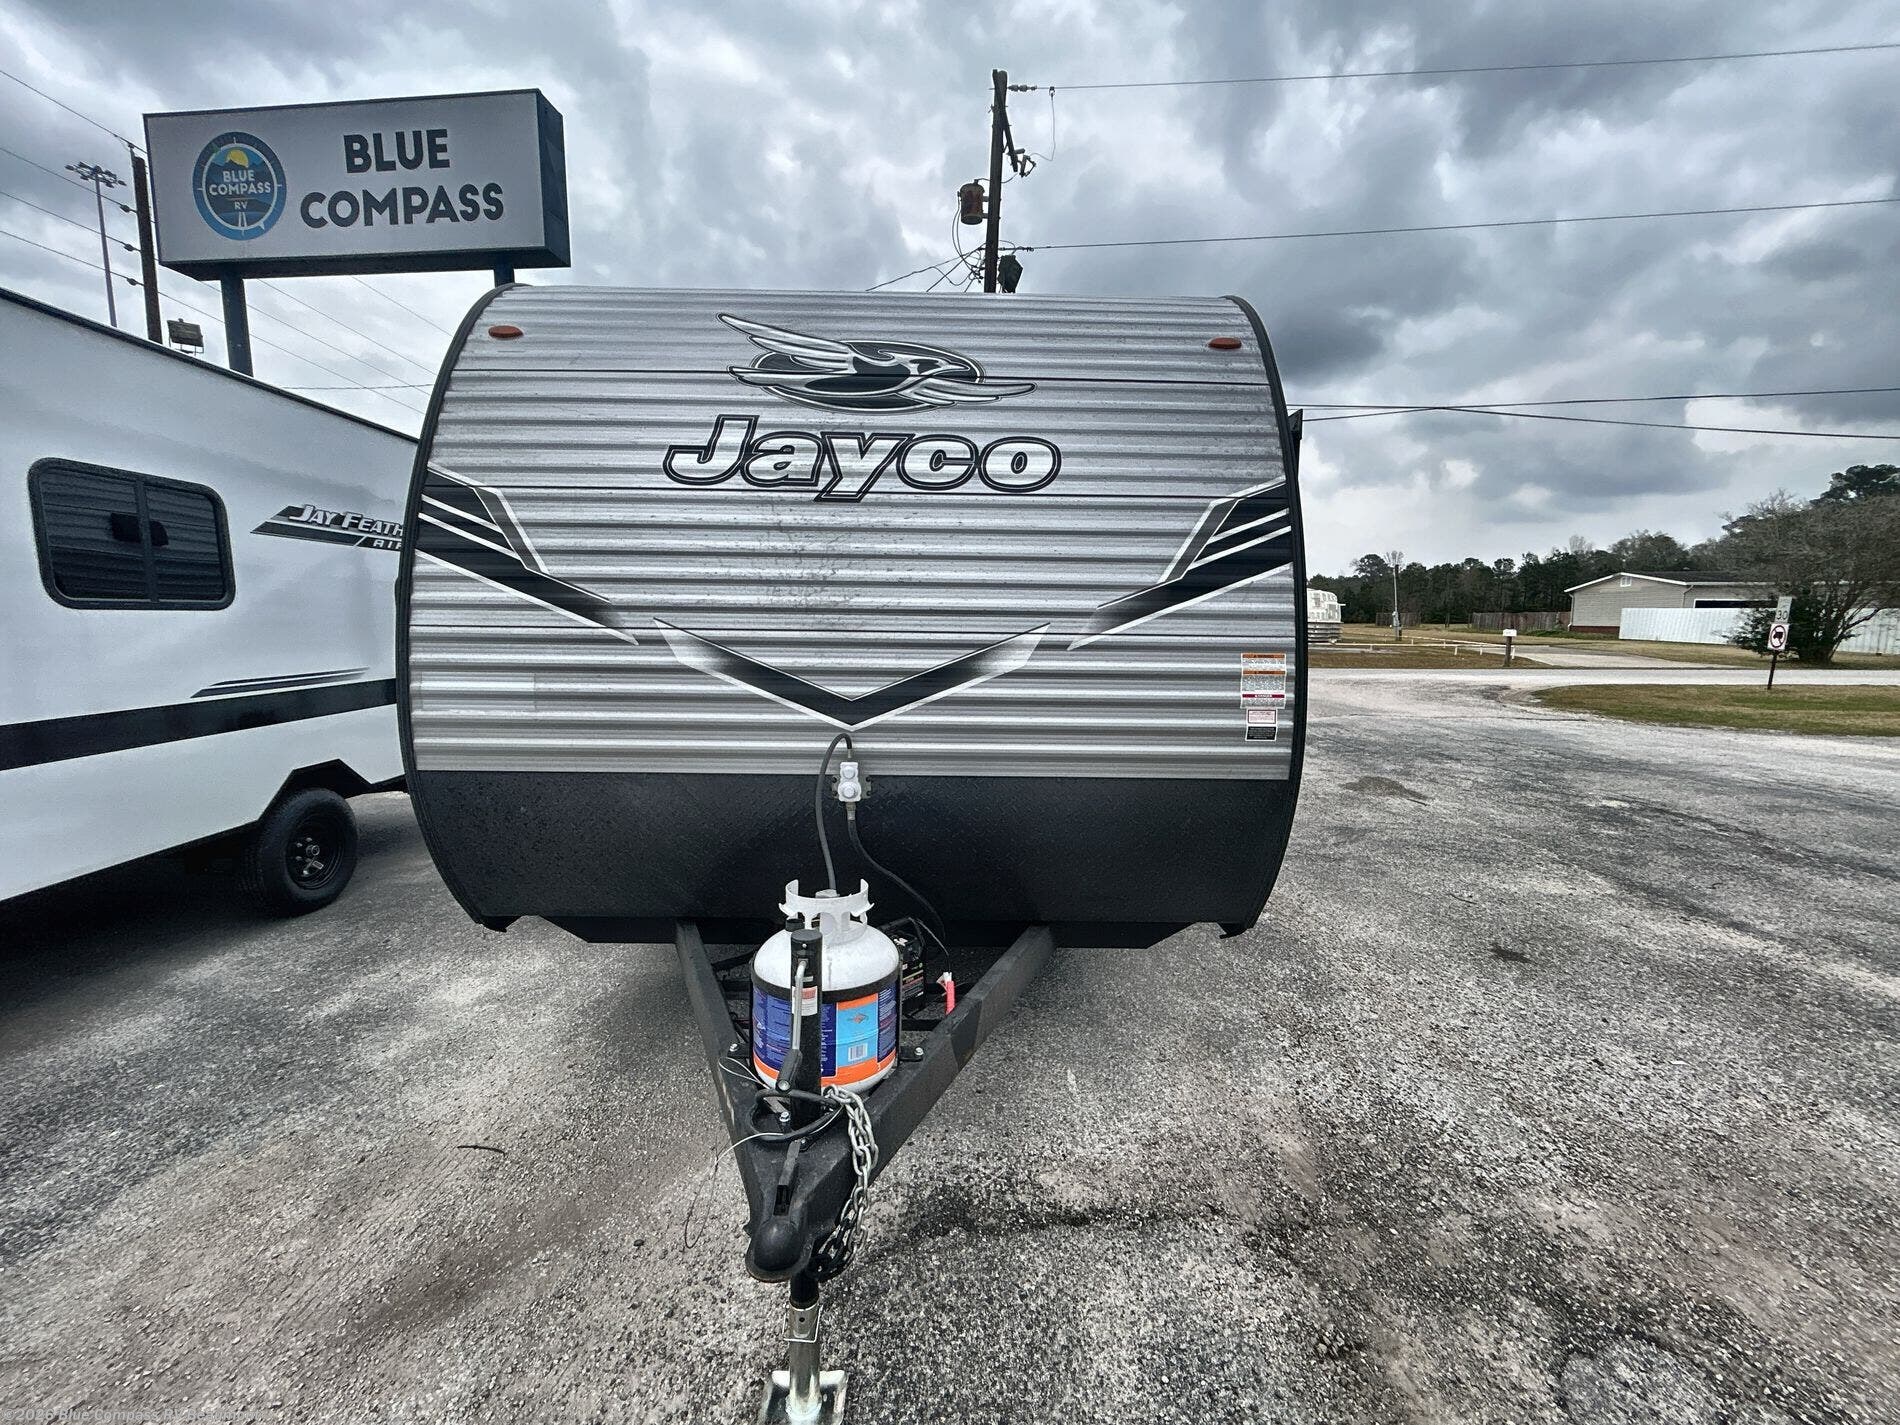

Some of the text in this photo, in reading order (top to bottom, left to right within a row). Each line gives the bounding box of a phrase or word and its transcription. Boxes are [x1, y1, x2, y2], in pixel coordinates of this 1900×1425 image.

[343, 129, 451, 173] BLUE
[222, 169, 256, 183] BLUE
[208, 181, 271, 196] COMPASS
[234, 201, 248, 210] RV
[300, 182, 504, 228] COMPASS
[662, 414, 1062, 502] Jayco
[288, 504, 337, 525] JAY
